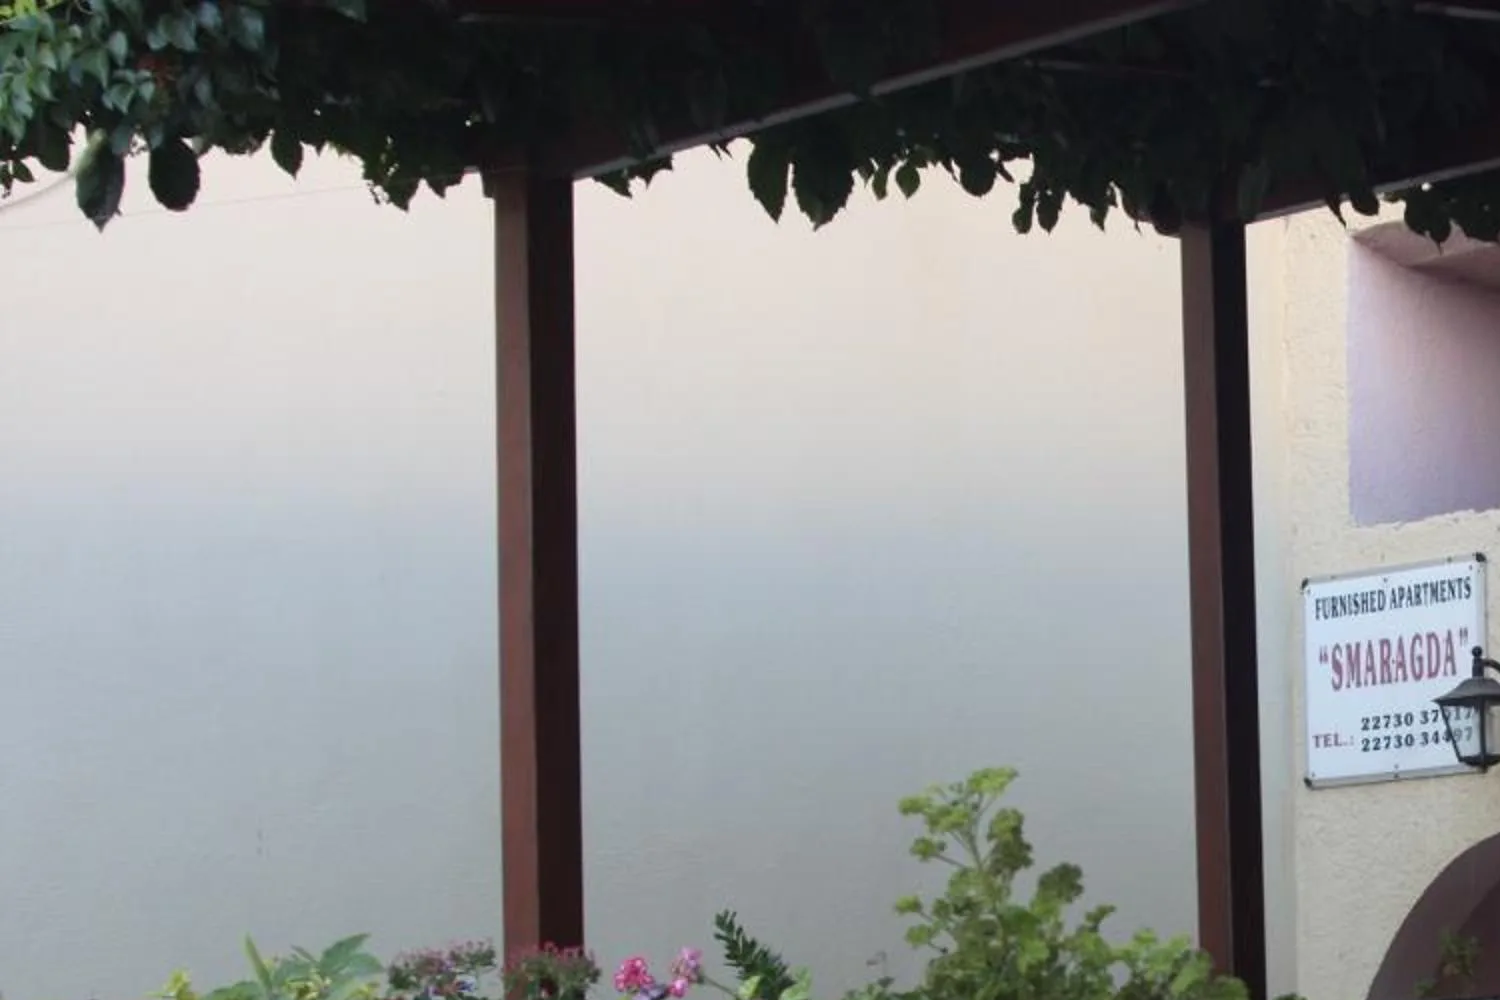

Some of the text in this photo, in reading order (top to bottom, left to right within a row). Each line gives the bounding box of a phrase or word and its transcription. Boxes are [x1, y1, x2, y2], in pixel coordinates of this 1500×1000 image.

[1315, 576, 1472, 621] FURNISHED APARTMENTS
[1361, 712, 1414, 731] 22730
[1361, 732, 1414, 752] 22730
